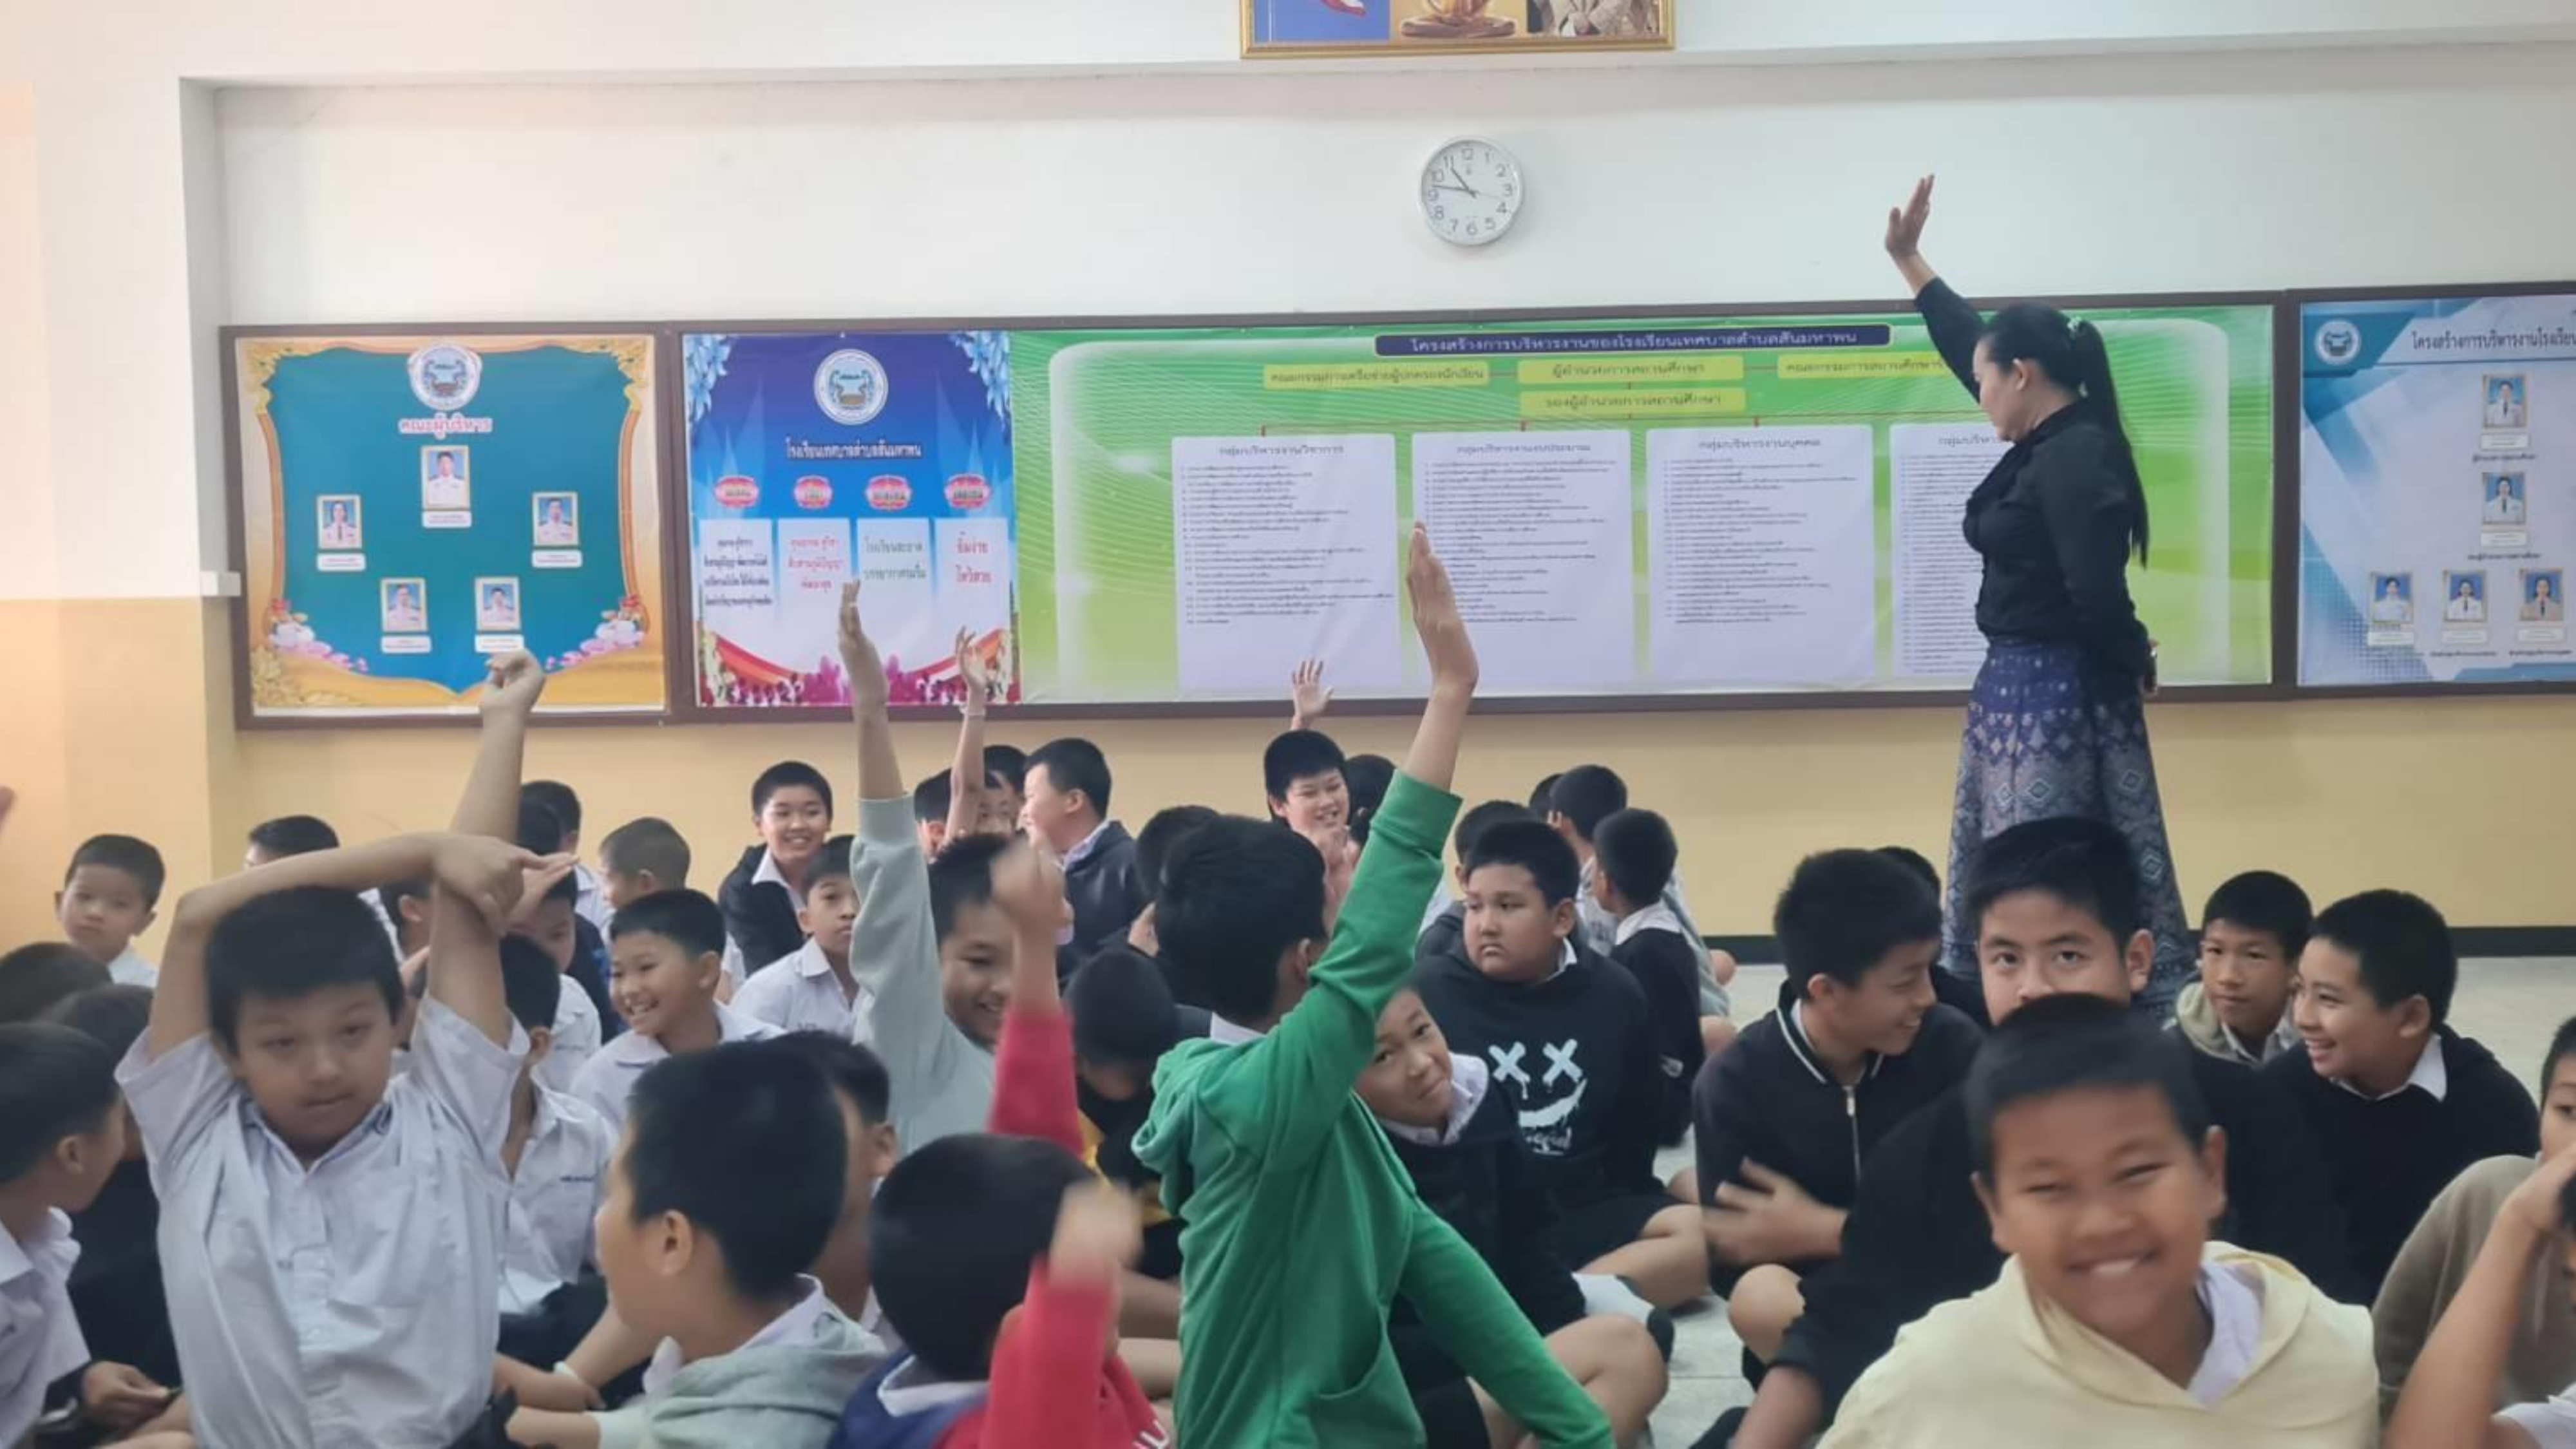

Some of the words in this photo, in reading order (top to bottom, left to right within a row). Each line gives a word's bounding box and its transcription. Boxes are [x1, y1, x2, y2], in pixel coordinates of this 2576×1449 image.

[1496, 163, 1506, 178] 2
[1428, 189, 1439, 201] 9
[1503, 183, 1513, 196] 3
[1435, 205, 1444, 220] 8
[1495, 201, 1508, 213] 4
[1450, 219, 1459, 232] 7
[1466, 222, 1478, 235] 6
[1485, 216, 1496, 230] 5
